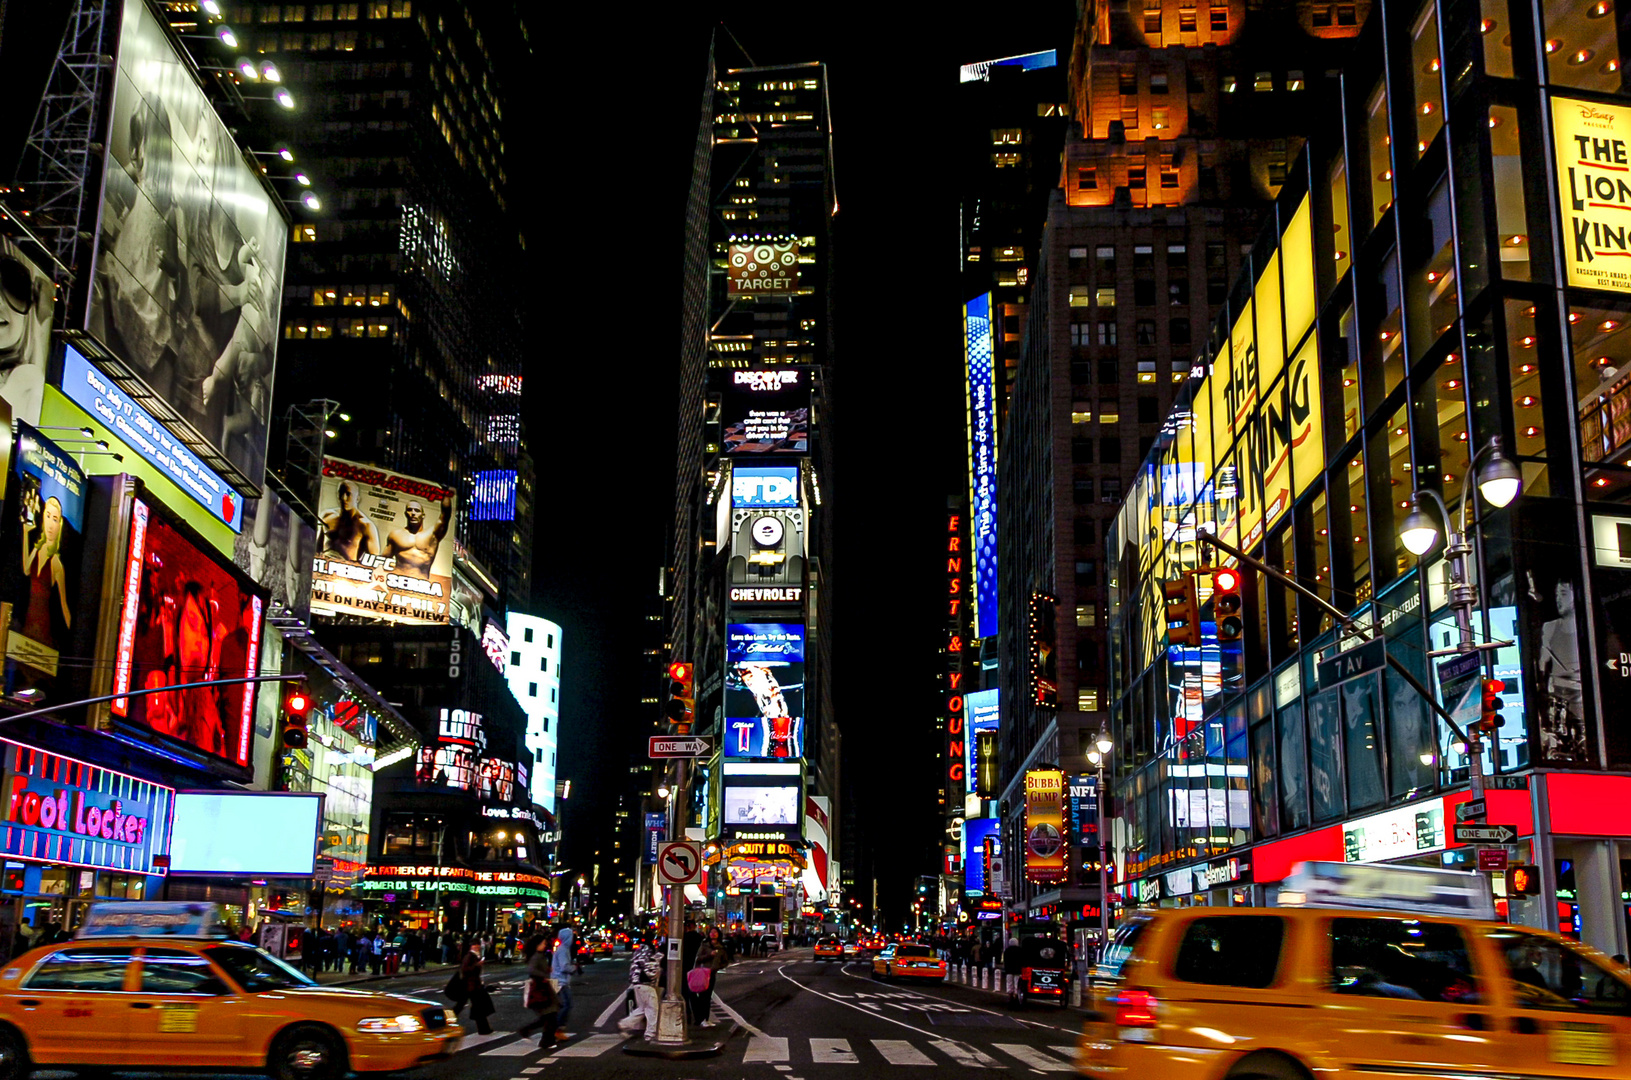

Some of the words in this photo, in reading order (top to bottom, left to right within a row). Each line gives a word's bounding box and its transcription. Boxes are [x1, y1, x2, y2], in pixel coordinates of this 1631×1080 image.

[1574, 135, 1628, 164] THE
[1568, 167, 1631, 211] LION
[1572, 217, 1631, 263] KIN
[1610, 272, 1631, 280] AWARD-
[735, 278, 792, 290] TARGET
[734, 370, 798, 384] DISCOVER
[1224, 341, 1257, 426] THE
[750, 382, 782, 390] CARD
[978, 445, 988, 475] time
[362, 552, 396, 571] UFC
[948, 515, 962, 615] ERNST
[386, 573, 444, 597] SERRA
[731, 588, 802, 601] CHEVROLET
[334, 595, 354, 606] ON
[356, 598, 445, 622] PAY-PER-VIEW
[437, 602, 446, 614] 7
[948, 635, 962, 652] &
[1335, 662, 1342, 678] 7
[949, 672, 964, 781] YOUNG
[658, 742, 677, 751] ONE
[684, 742, 704, 751] WAY
[1028, 776, 1060, 788] BUBBA
[1506, 778, 1516, 788] 45
[1030, 790, 1058, 802] GUMP
[1069, 786, 1097, 798] NFL
[10, 775, 68, 831] Foot
[74, 790, 147, 844] Locker
[482, 806, 510, 818] Love.
[1072, 798, 1080, 832] DRAFT
[736, 832, 786, 840] Panasonic
[1462, 830, 1480, 838] ONE
[1488, 830, 1508, 838] WAY
[379, 866, 416, 876] FATHER
[416, 866, 434, 876] OF
[474, 872, 492, 881] THE
[493, 872, 516, 881] TALK
[1206, 860, 1231, 884] element
[396, 880, 425, 890] DUE
[476, 886, 518, 895] ACCUSED
